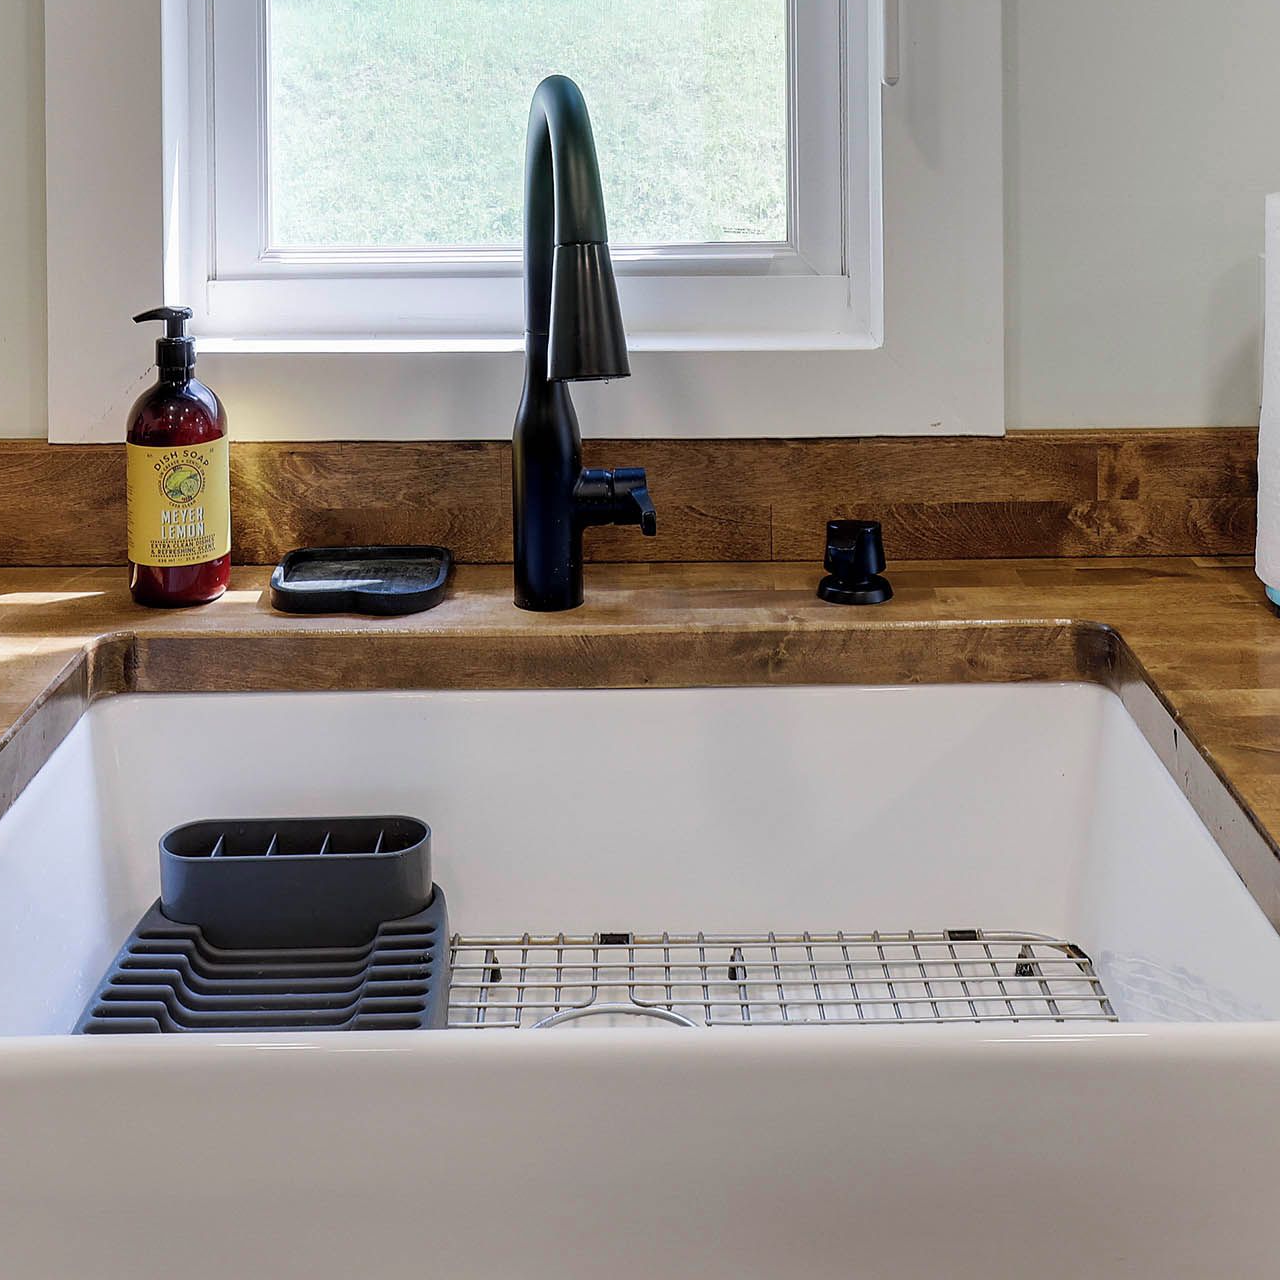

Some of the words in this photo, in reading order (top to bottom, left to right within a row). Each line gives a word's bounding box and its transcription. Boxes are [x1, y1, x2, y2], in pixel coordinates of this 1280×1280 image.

[153, 450, 179, 472] DISH
[182, 449, 209, 466] SOAP
[161, 506, 205, 524] MEYER
[161, 523, 205, 540] LEMON
